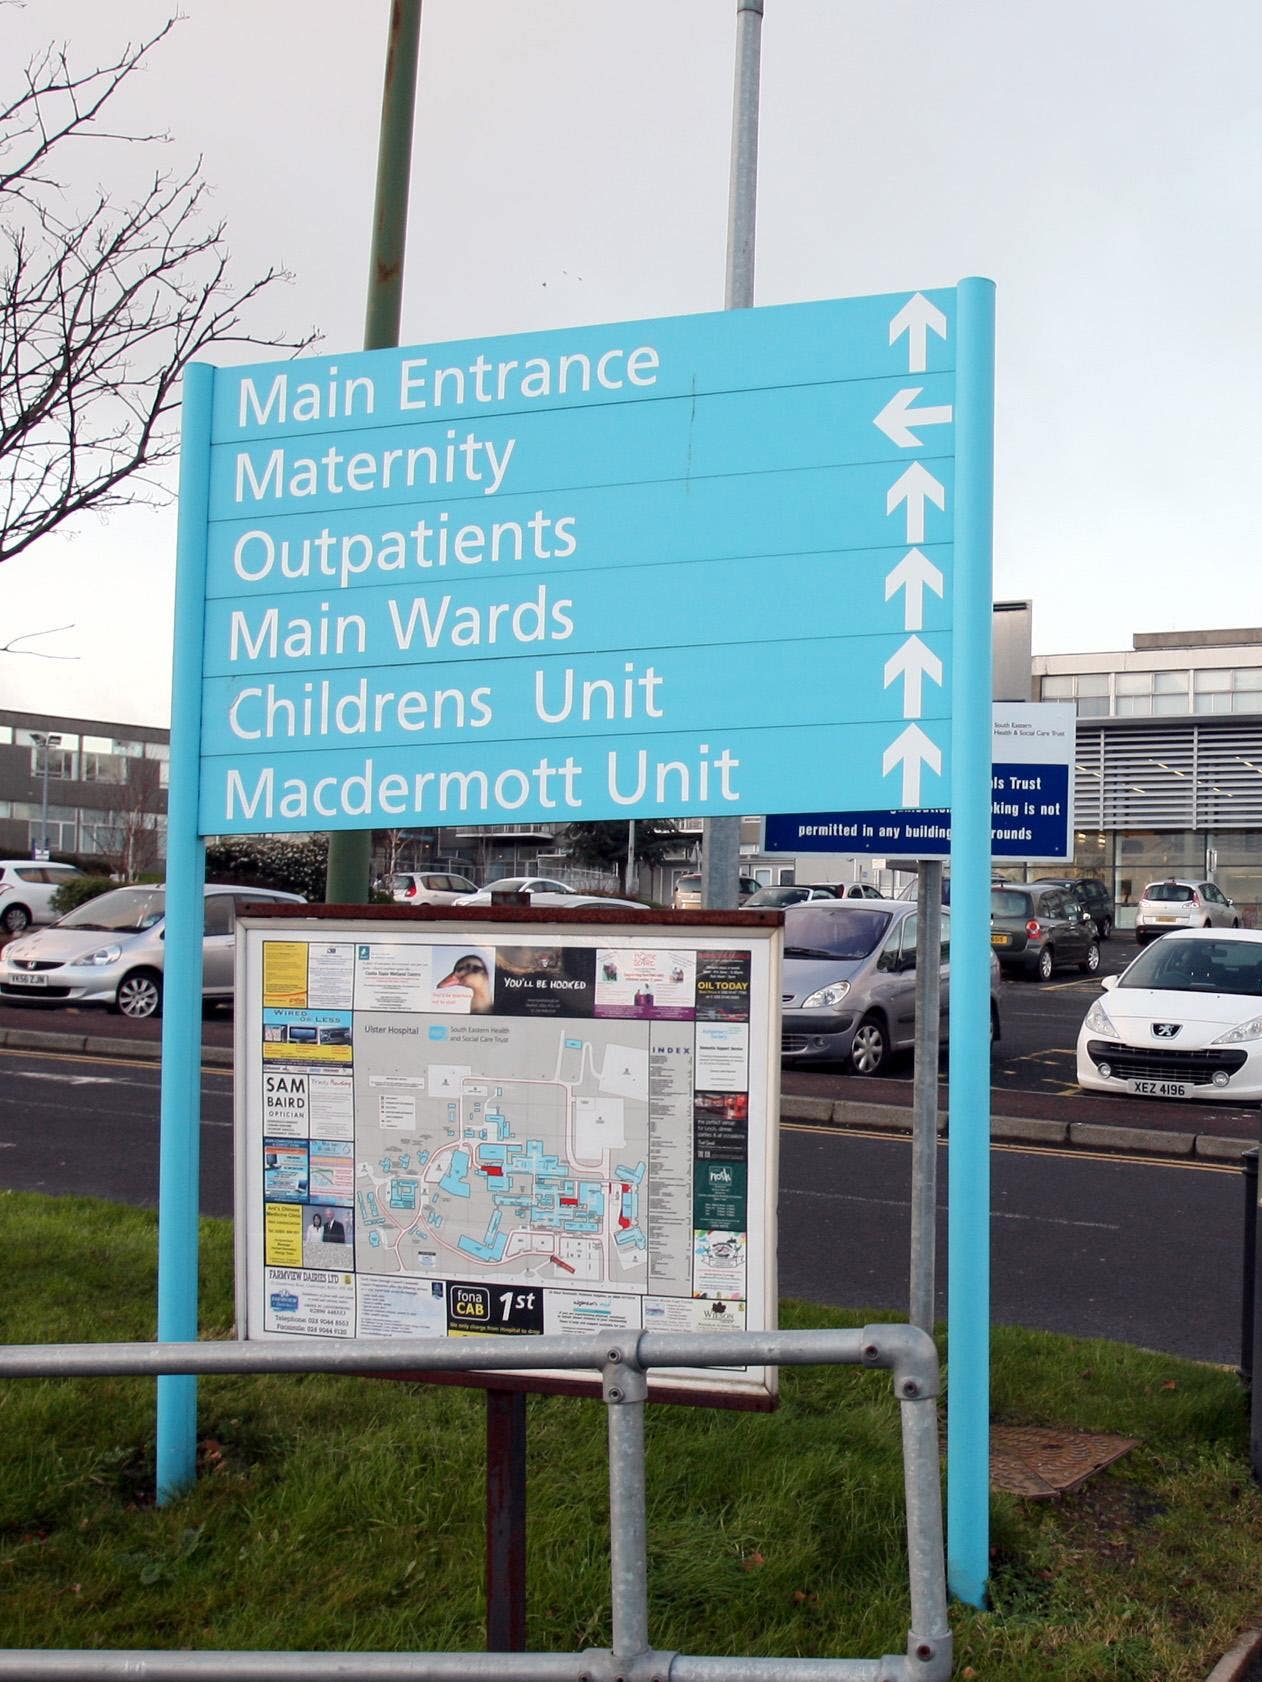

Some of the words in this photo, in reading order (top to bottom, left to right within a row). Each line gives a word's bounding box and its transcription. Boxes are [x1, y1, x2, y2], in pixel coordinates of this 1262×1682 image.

[236, 366, 376, 428] Main
[400, 346, 660, 411] Entrance
[235, 430, 516, 503] Maternity
[233, 510, 577, 588] Outpatients
[229, 602, 367, 661] Main
[387, 584, 575, 650] Wards
[228, 678, 493, 740] Childrens
[533, 661, 664, 724] Unit
[226, 756, 583, 820] Macdermott
[608, 744, 740, 805] Unit
[991, 776, 1005, 790] ls
[1009, 776, 1042, 790] Trust
[991, 801, 1019, 817] king
[1024, 801, 1035, 815] is
[1040, 802, 1060, 816] not
[798, 823, 857, 837] permitted
[862, 824, 874, 837] in
[878, 826, 900, 839] any
[504, 977, 534, 988] YOU'LL
[536, 979, 548, 989] BE
[550, 980, 587, 990] HOOKED
[697, 981, 714, 990] OIL
[715, 981, 749, 991] TODAY
[364, 1025, 386, 1034] Ulster
[387, 1025, 420, 1036] Hospital
[449, 1026, 466, 1034] South
[466, 1026, 489, 1034] Eastern
[490, 1027, 510, 1035] Health
[450, 1034, 461, 1043] and
[461, 1035, 480, 1043] Social
[494, 1036, 509, 1044] Trust
[652, 1046, 690, 1054] INDEX
[266, 1077, 306, 1094] SAM
[1133, 1082, 1157, 1094] XEZ
[1159, 1083, 1186, 1096] 4196
[267, 1096, 305, 1109] BAIRD
[268, 1110, 305, 1119] OPTICIAN
[710, 1167, 732, 1182] nosh
[269, 1269, 303, 1281] FARMVIEW
[302, 1271, 328, 1283] DAIRIES
[327, 1273, 340, 1284] LTD
[457, 1289, 483, 1303] fona
[456, 1302, 484, 1316] CAB
[499, 1291, 536, 1321] 1st
